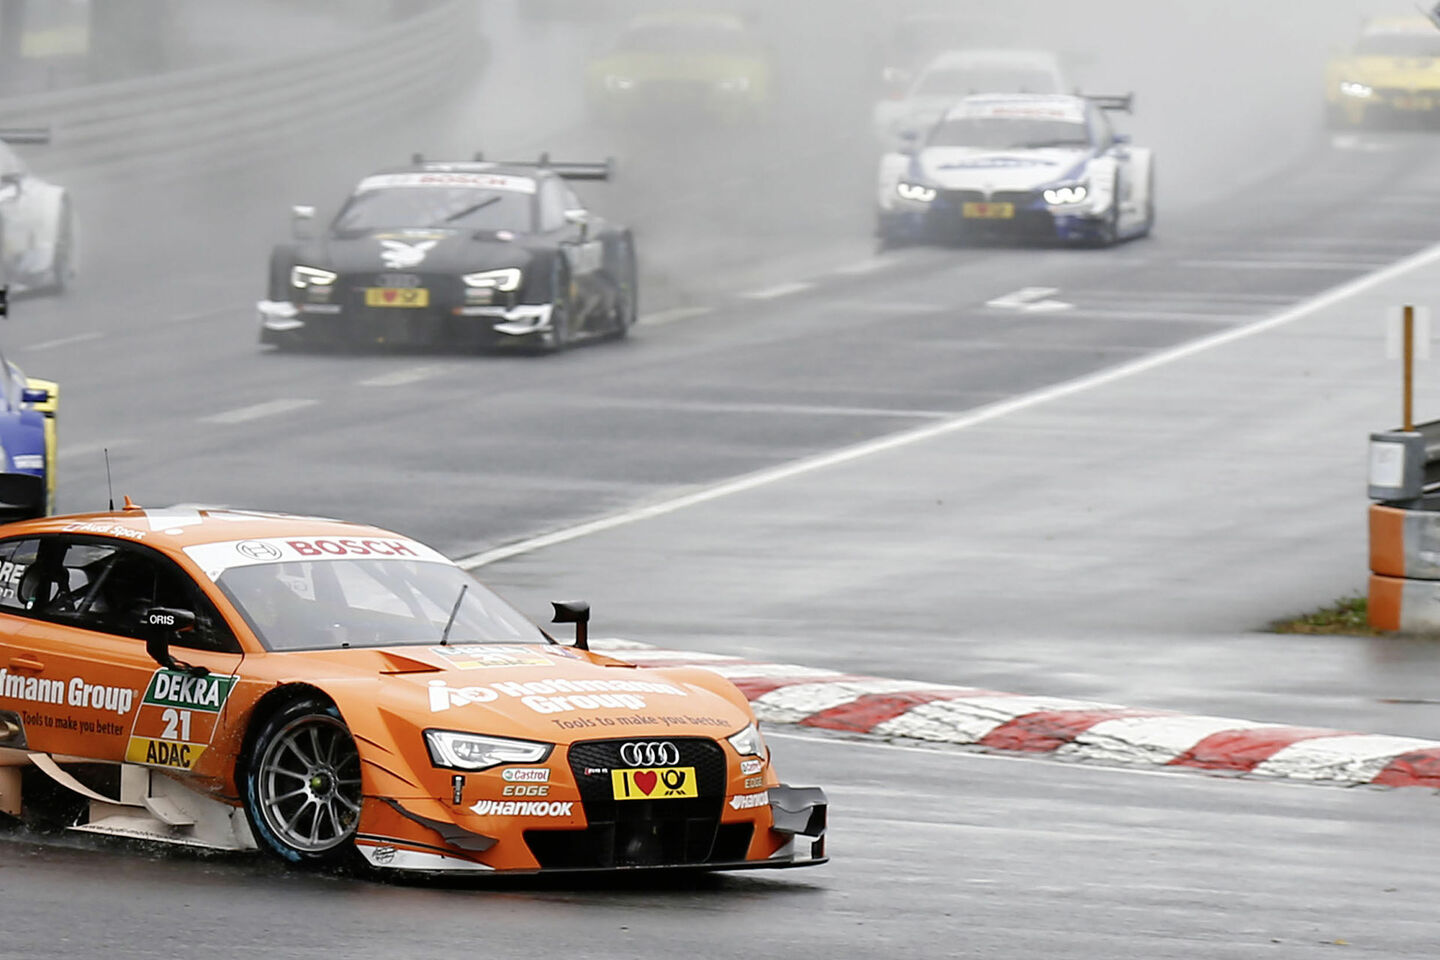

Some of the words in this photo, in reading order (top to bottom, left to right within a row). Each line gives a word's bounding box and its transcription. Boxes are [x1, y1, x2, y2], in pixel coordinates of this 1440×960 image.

[287, 539, 420, 557] BOSCH
[149, 614, 175, 626] ORIS
[154, 672, 220, 707] DEKRA
[492, 678, 688, 697] Hoffmann
[22, 711, 43, 726] Tools
[45, 715, 54, 728] to
[55, 715, 78, 732] make
[79, 721, 95, 734] you
[96, 721, 125, 737] better
[161, 708, 192, 741] 21
[553, 717, 594, 731] Tools
[598, 716, 615, 727] to
[618, 713, 659, 726] make
[661, 715, 686, 727] you
[690, 714, 732, 728] better
[146, 740, 191, 768] ADAC
[514, 770, 547, 781] Castrol
[622, 771, 630, 797] I
[502, 785, 550, 797] EDGE
